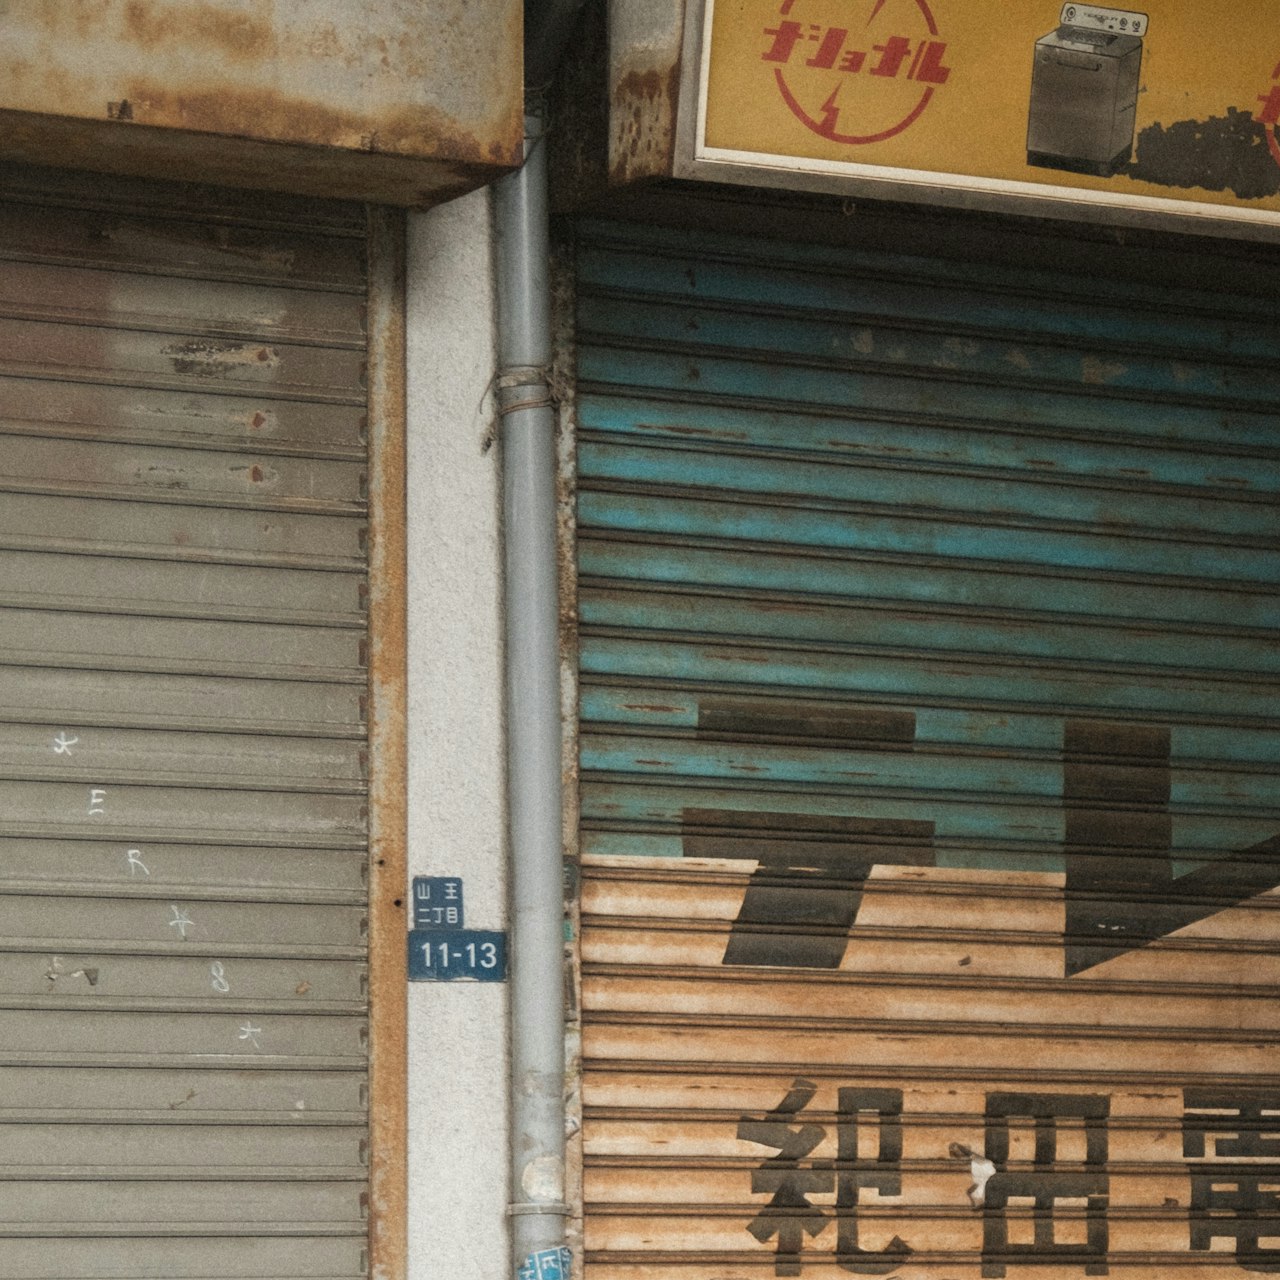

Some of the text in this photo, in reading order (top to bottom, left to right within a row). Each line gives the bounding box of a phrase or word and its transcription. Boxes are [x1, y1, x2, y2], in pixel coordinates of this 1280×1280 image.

[762, 20, 951, 85] ナショナル
[417, 882, 459, 900] 山王
[418, 906, 459, 924] 二丁目
[421, 942, 497, 969] 11-13
